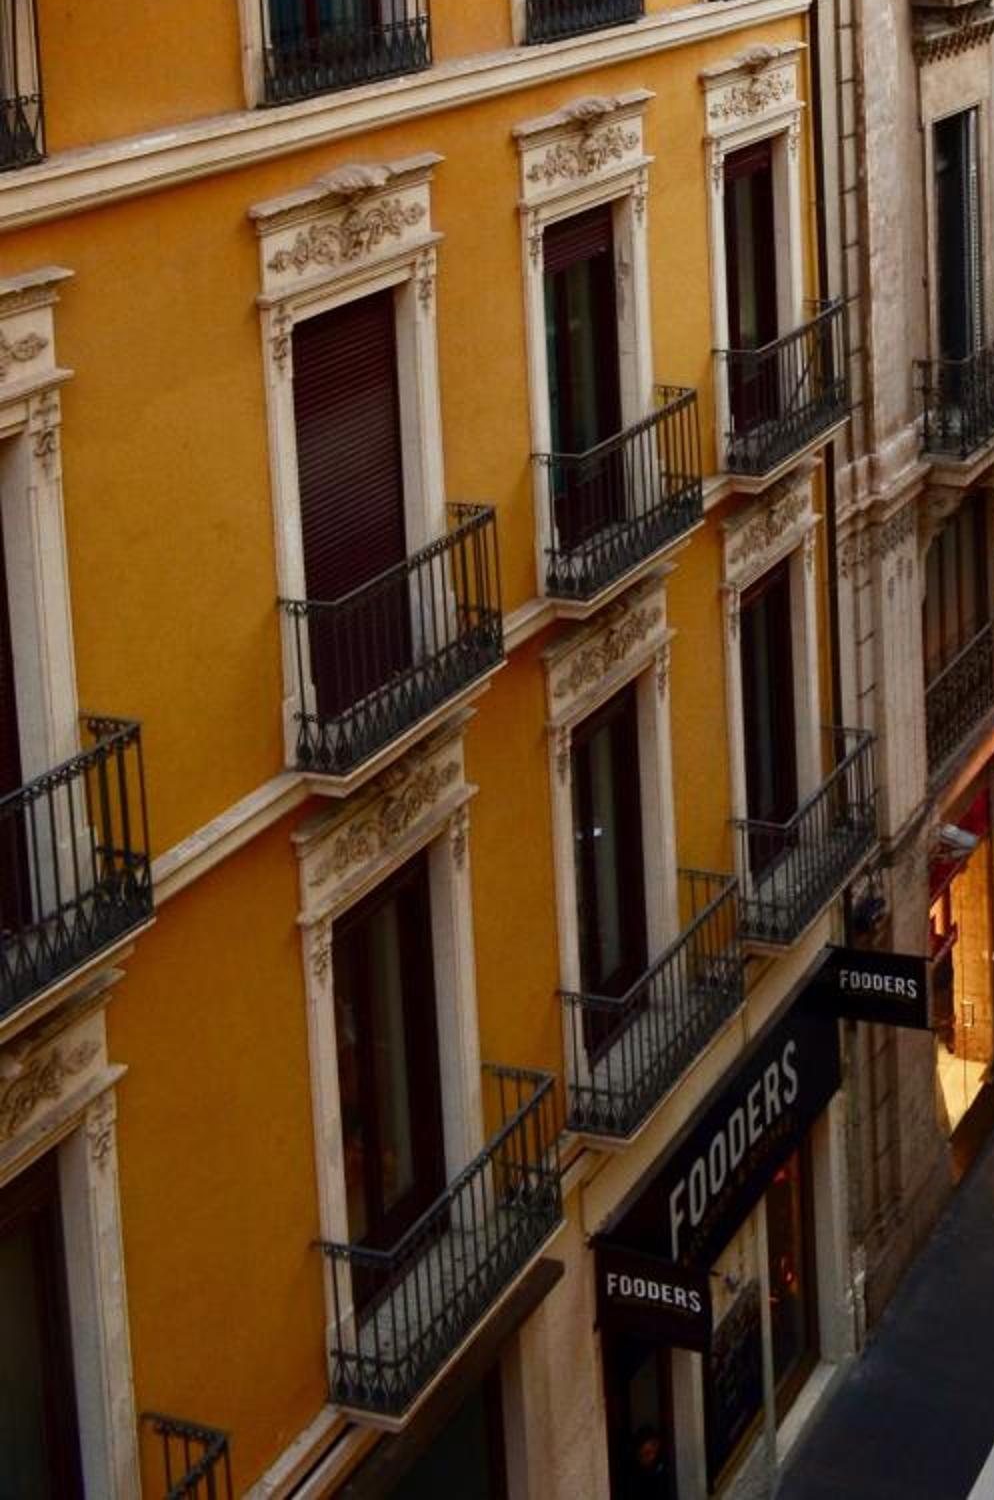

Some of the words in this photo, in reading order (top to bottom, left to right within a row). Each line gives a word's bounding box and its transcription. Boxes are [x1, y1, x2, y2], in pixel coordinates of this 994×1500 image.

[839, 969, 919, 999] FOODERS
[668, 1039, 799, 1261] FOODERS
[606, 1272, 702, 1313] FOODERS
